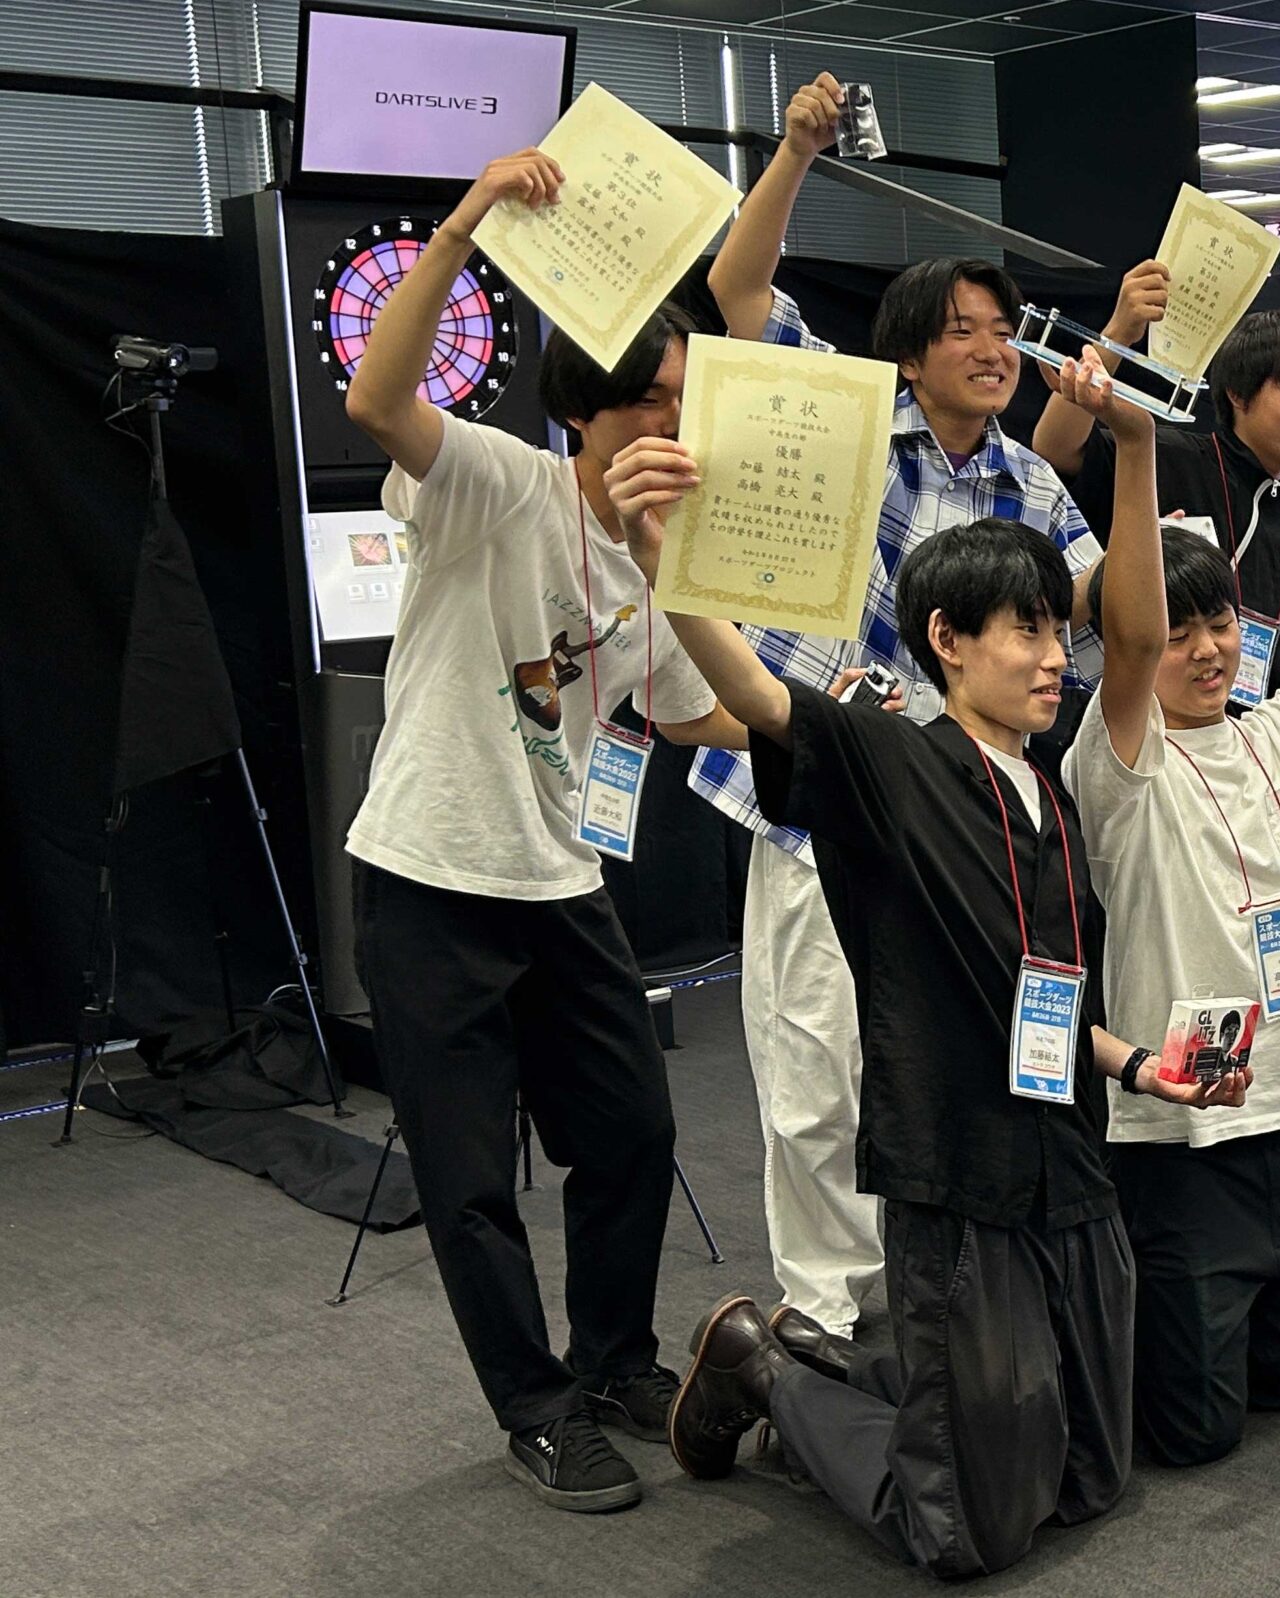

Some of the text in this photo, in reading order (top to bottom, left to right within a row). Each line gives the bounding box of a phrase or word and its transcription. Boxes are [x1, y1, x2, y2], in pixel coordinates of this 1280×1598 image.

[375, 91, 498, 115] DARTSLIVE 3
[373, 225, 381, 236] 5
[400, 221, 412, 232] 20
[345, 239, 357, 250] 12
[327, 260, 336, 271] 9
[479, 264, 488, 275] 4
[314, 289, 326, 300] 14
[493, 292, 505, 303] 13
[312, 320, 323, 331] 11
[501, 322, 510, 333] 6
[321, 352, 330, 363] 8
[498, 352, 509, 362] 10
[336, 380, 348, 391] 16
[487, 378, 499, 389] 15
[471, 401, 478, 411] 2
[1198, 1010, 1213, 1025] GL
